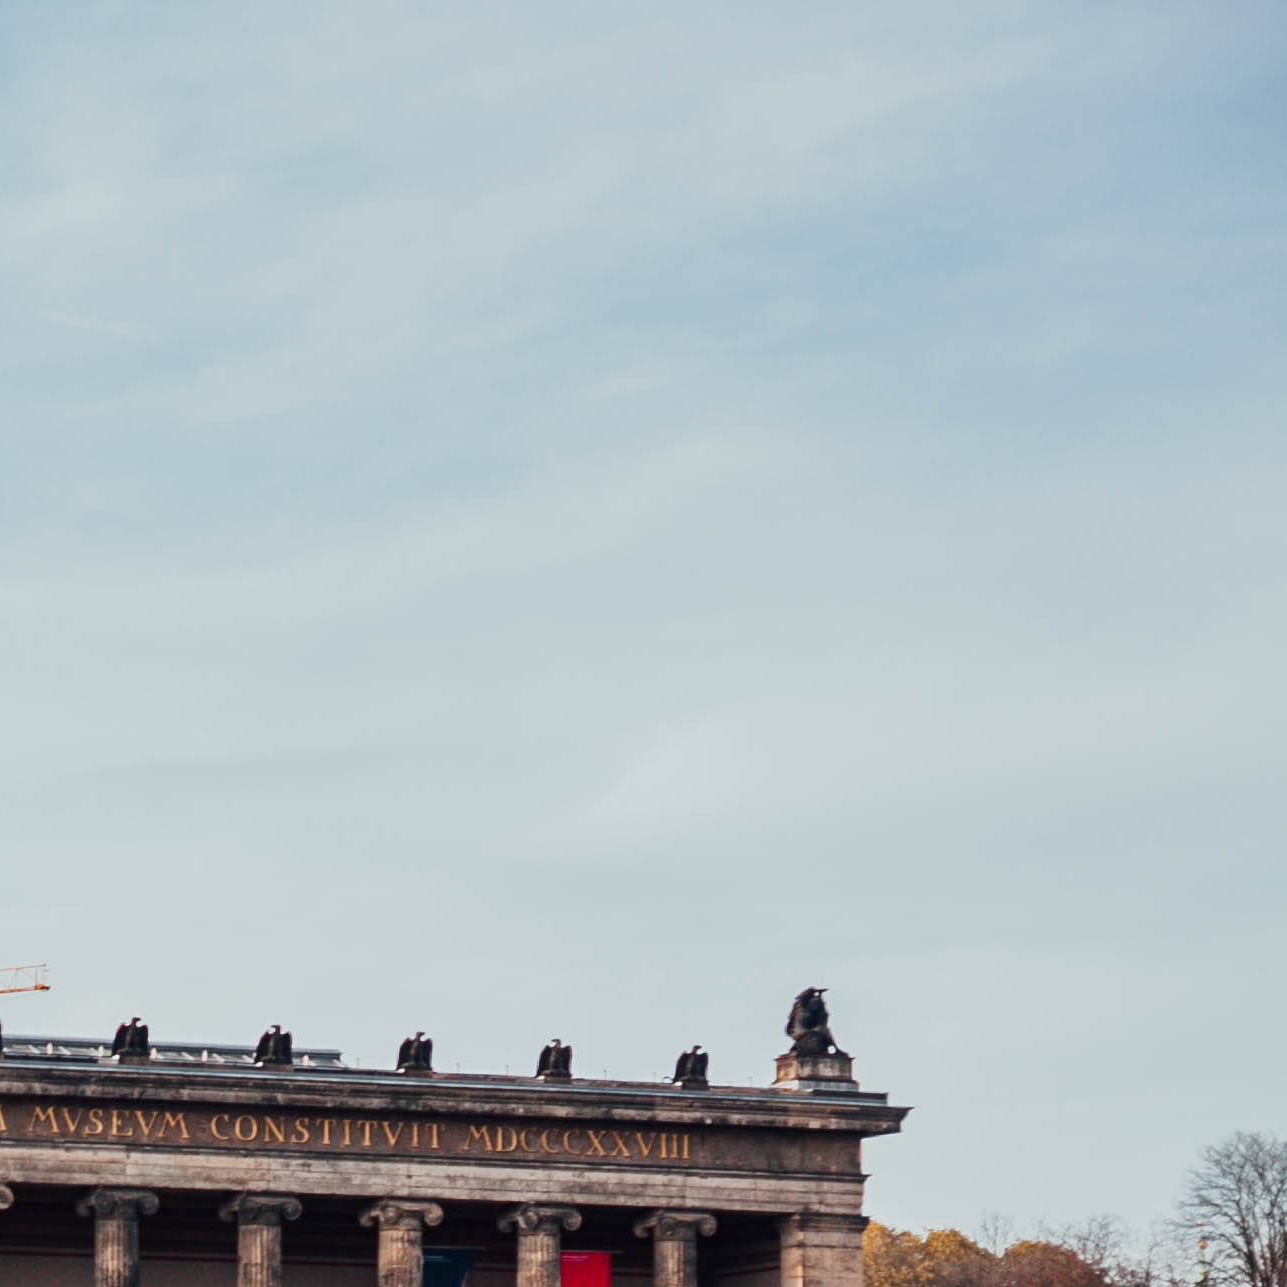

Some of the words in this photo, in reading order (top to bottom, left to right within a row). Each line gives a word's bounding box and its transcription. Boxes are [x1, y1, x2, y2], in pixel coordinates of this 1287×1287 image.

[28, 1106, 191, 1139] MVSEVM
[210, 1114, 446, 1150] CONSTITVIT
[463, 1125, 691, 1160] MDCCCXXVIII
